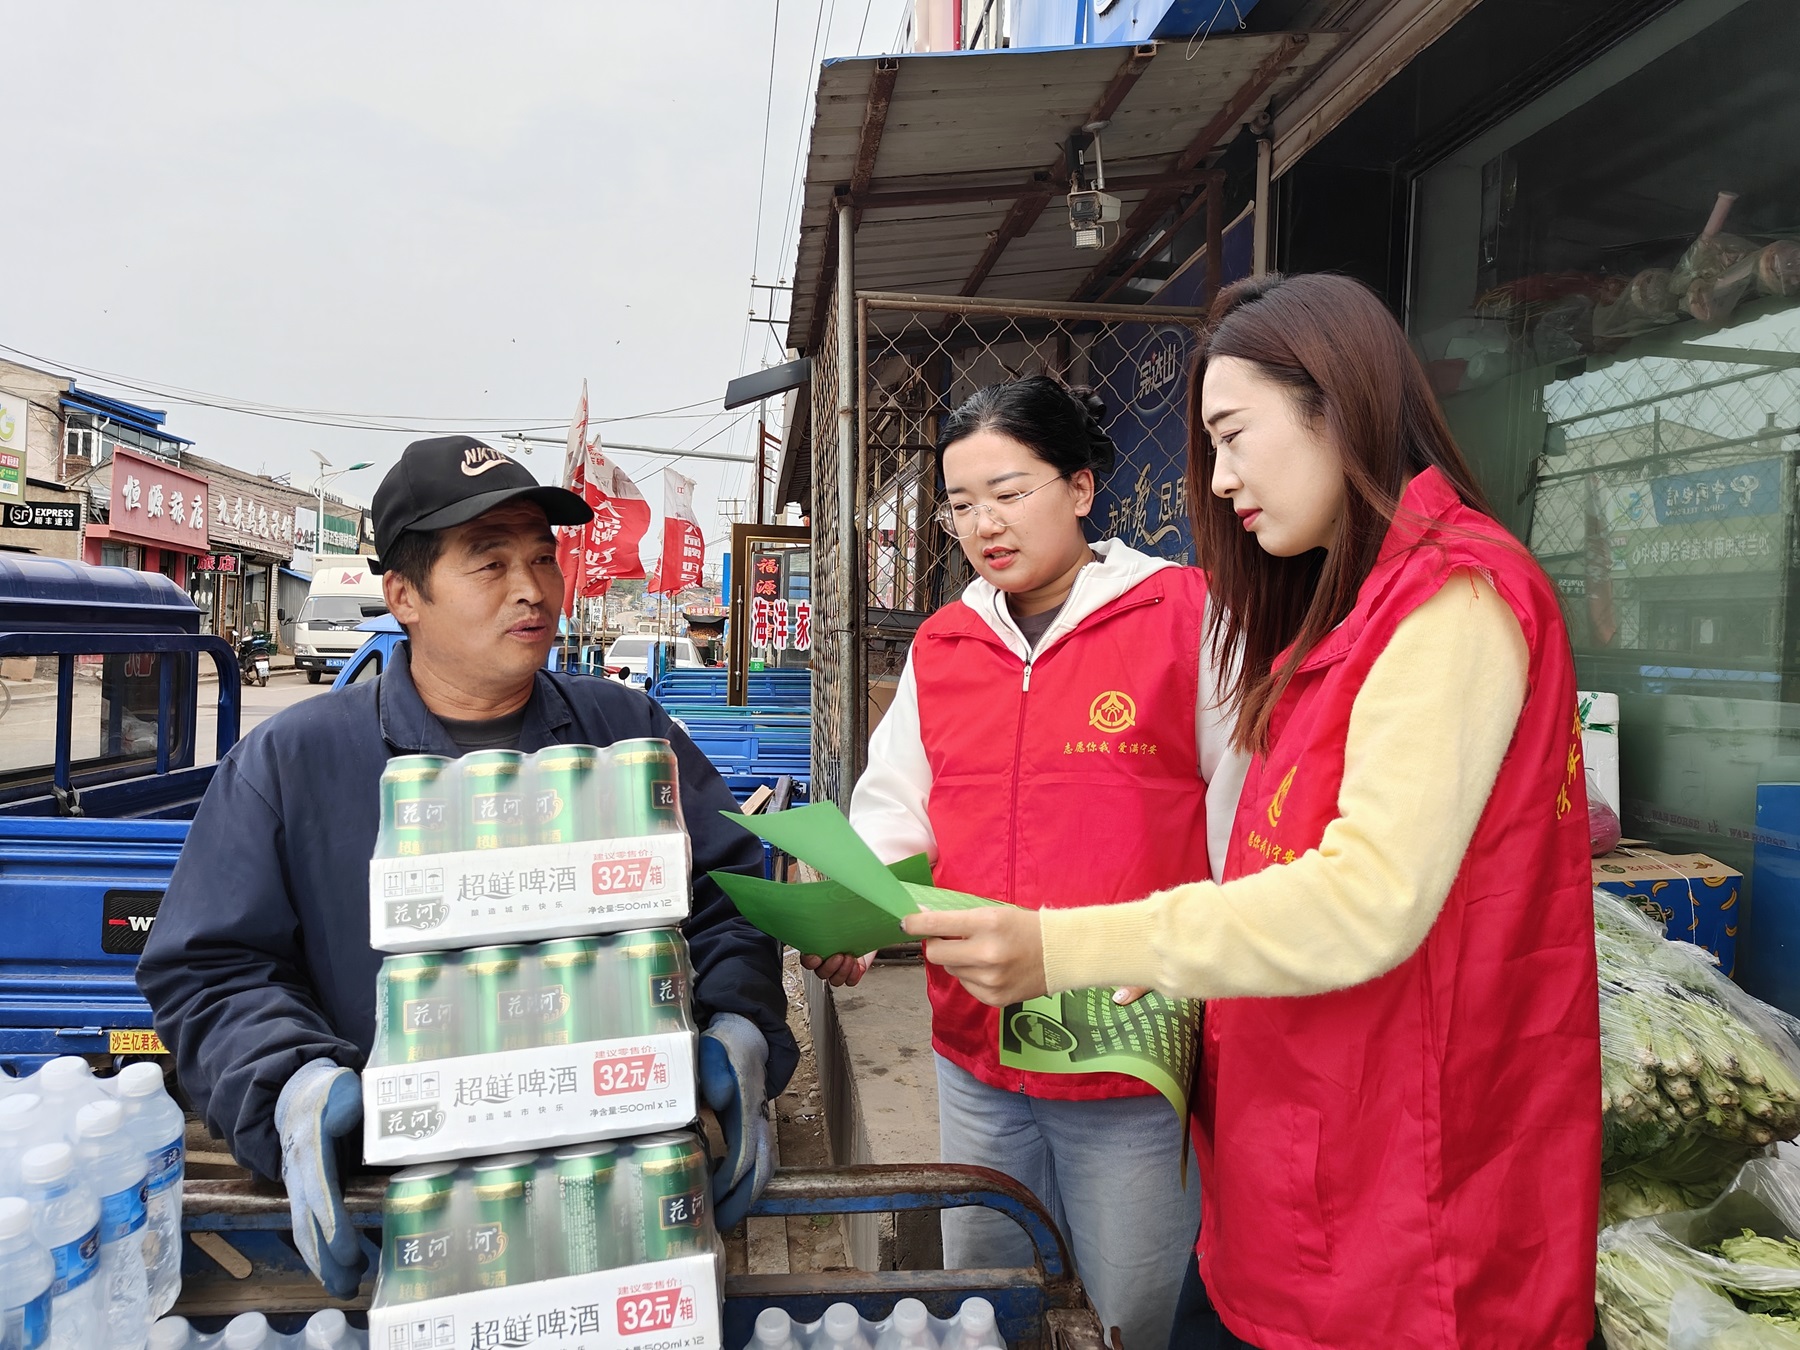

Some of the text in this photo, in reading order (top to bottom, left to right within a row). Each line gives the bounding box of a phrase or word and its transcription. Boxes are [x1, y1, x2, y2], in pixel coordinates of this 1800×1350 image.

[1139, 344, 1176, 399] 完达山
[35, 508, 74, 518] EXPRESS
[197, 555, 236, 571] 旅店
[1063, 741, 1158, 755] 志愿你我 爱满宁安
[404, 803, 445, 824] 花河
[481, 798, 521, 818] 花河
[594, 849, 653, 860] 建议零售价:
[457, 866, 577, 901] 超鲜啤酒
[395, 903, 436, 924] 花河
[471, 901, 563, 916] 酿造城市快乐
[128, 916, 157, 931] W
[112, 1033, 168, 1051] 沙兰亿君家
[594, 1046, 657, 1059] 建议零售价:
[453, 1065, 578, 1107] 超鲜啤酒
[388, 1110, 432, 1134] 花河
[468, 1104, 564, 1123] 酿造城市快乐
[403, 1239, 449, 1265] 花河
[617, 1279, 683, 1295] 建议零售价:
[470, 1303, 600, 1350] 超鲜啤酒
